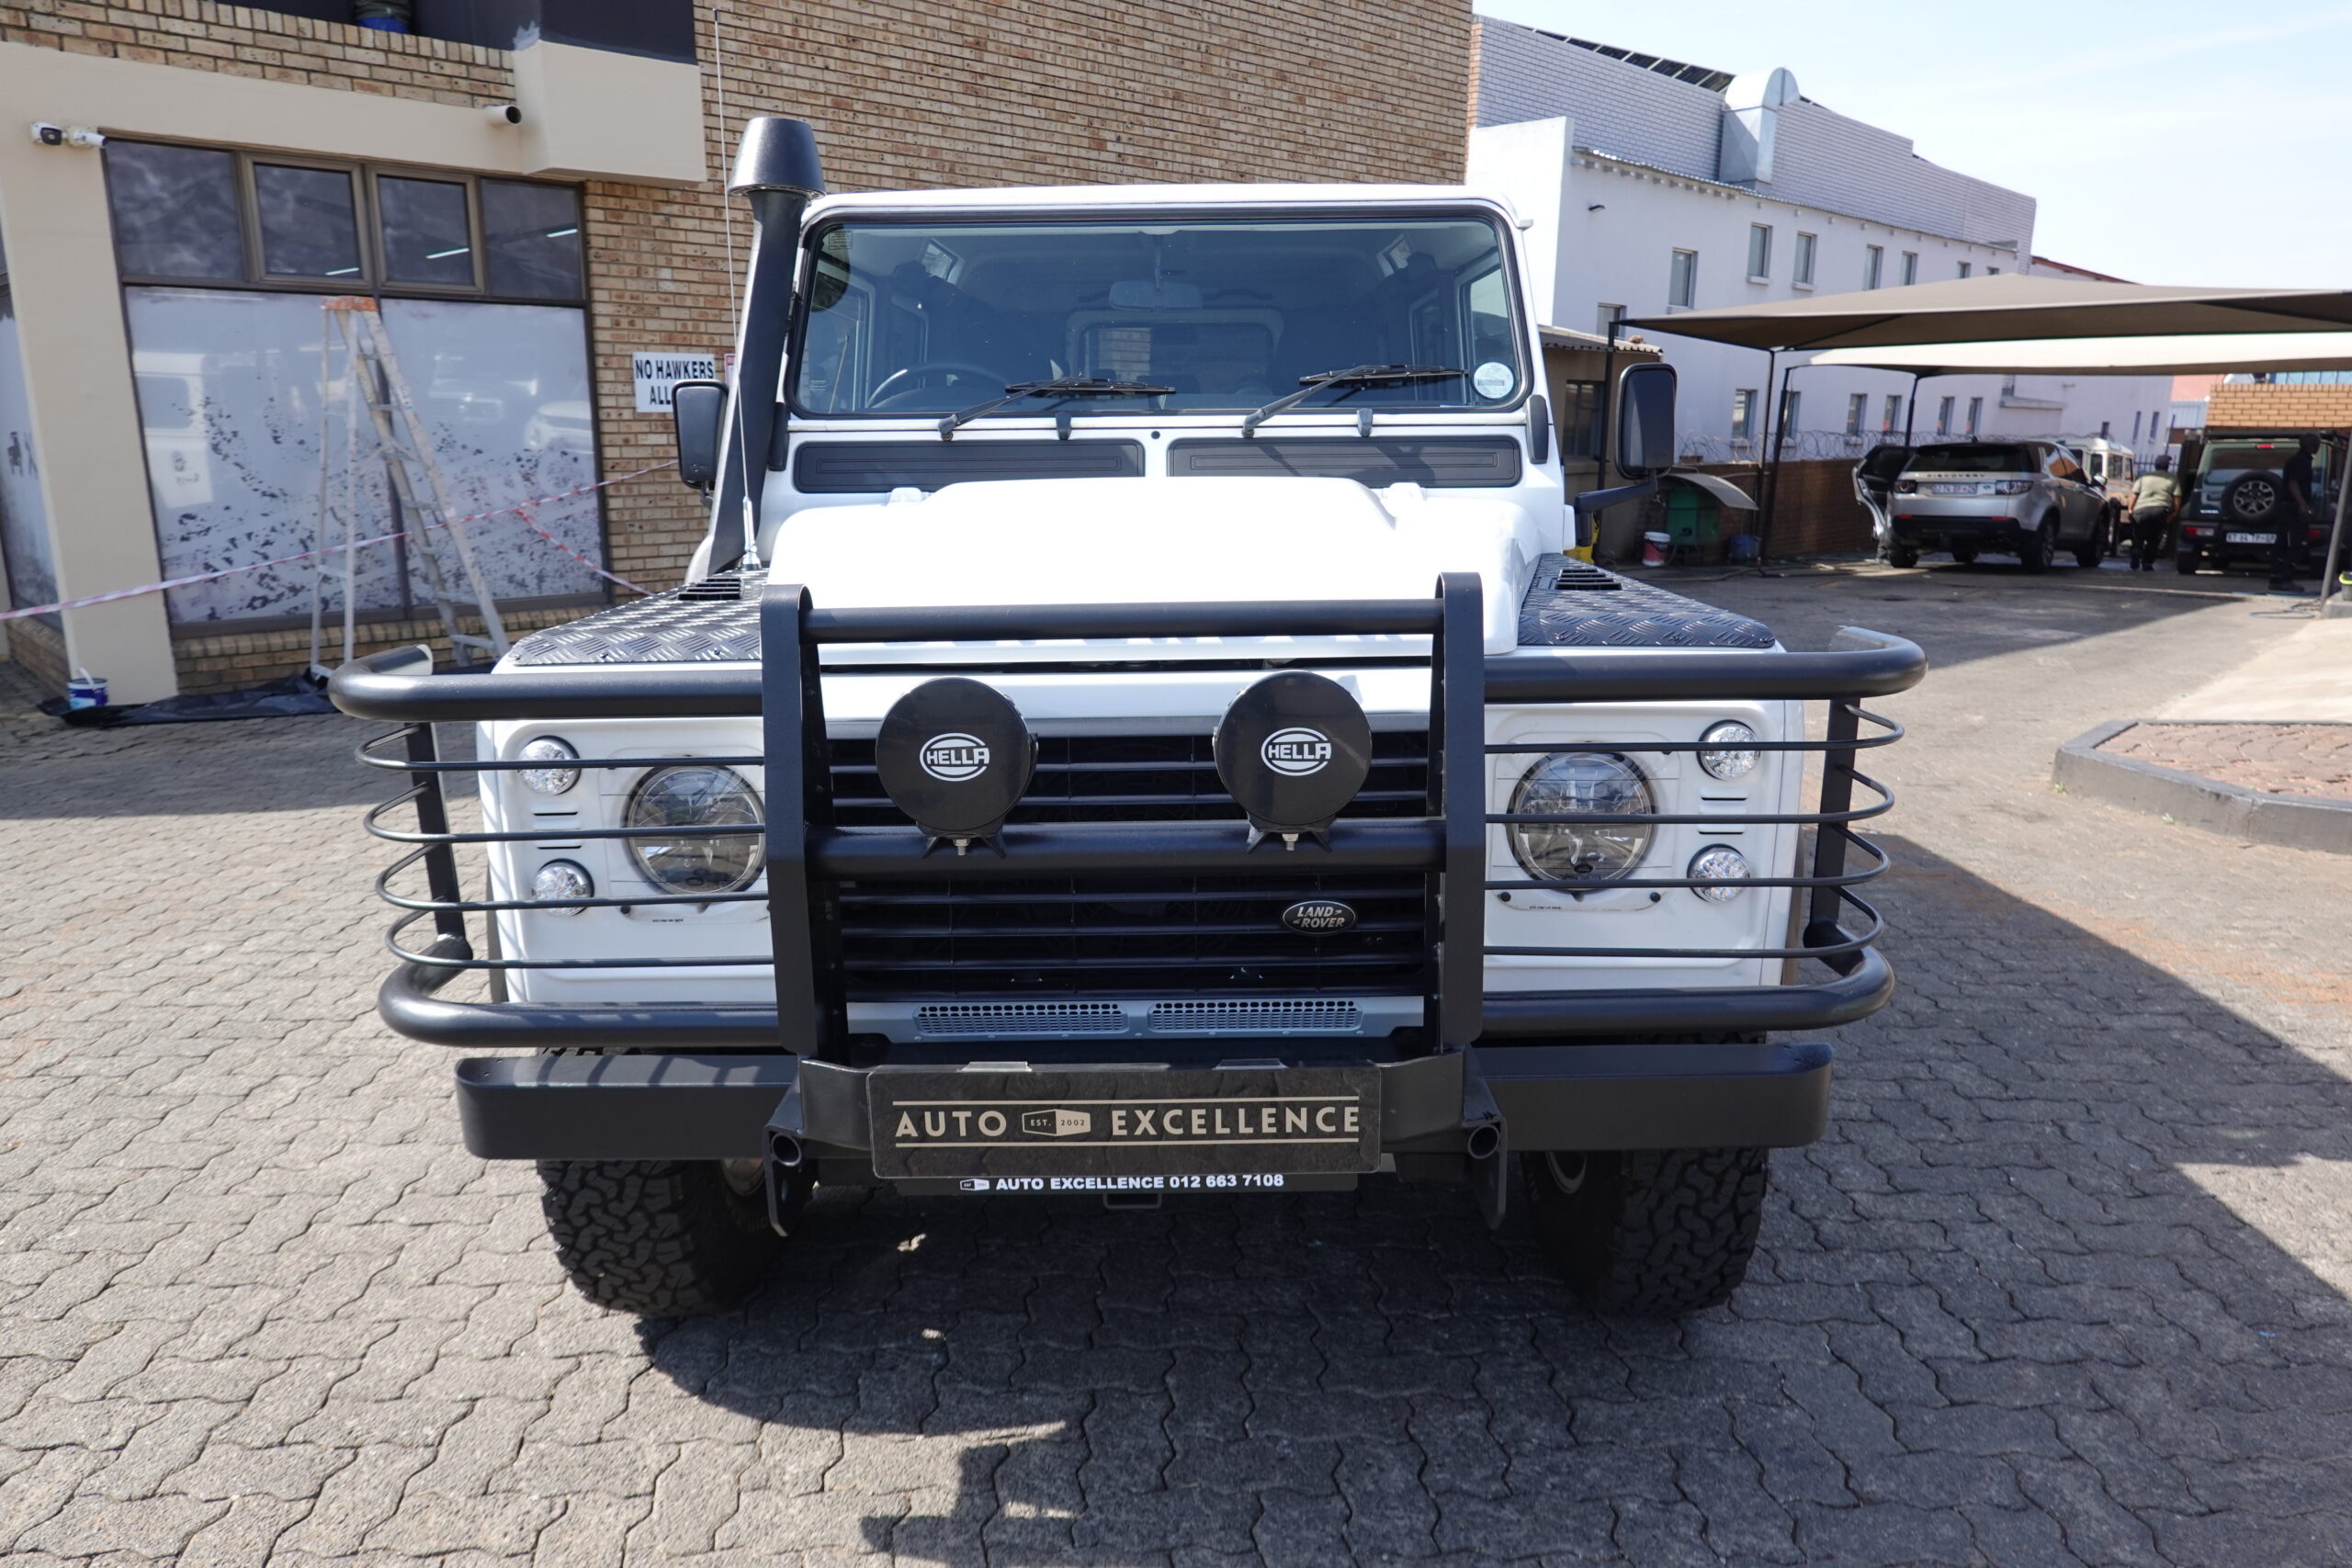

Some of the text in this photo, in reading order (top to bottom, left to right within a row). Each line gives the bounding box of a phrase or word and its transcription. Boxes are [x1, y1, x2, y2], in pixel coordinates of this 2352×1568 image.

[636, 360, 652, 378] NO
[656, 360, 714, 379] HAWKERS
[650, 386, 671, 405] ALL
[926, 748, 989, 764] HELLA
[1268, 742, 1331, 760] HELLA
[1296, 907, 1334, 918] LAND
[1300, 918, 1345, 928] ROVER
[895, 1111, 1007, 1137] AUTO
[1030, 1119, 1052, 1127] EST.
[1112, 1106, 1359, 1136] EXCELLENCE
[996, 1174, 1283, 1190] AUTO EXCELLENCE 012 663 7108
